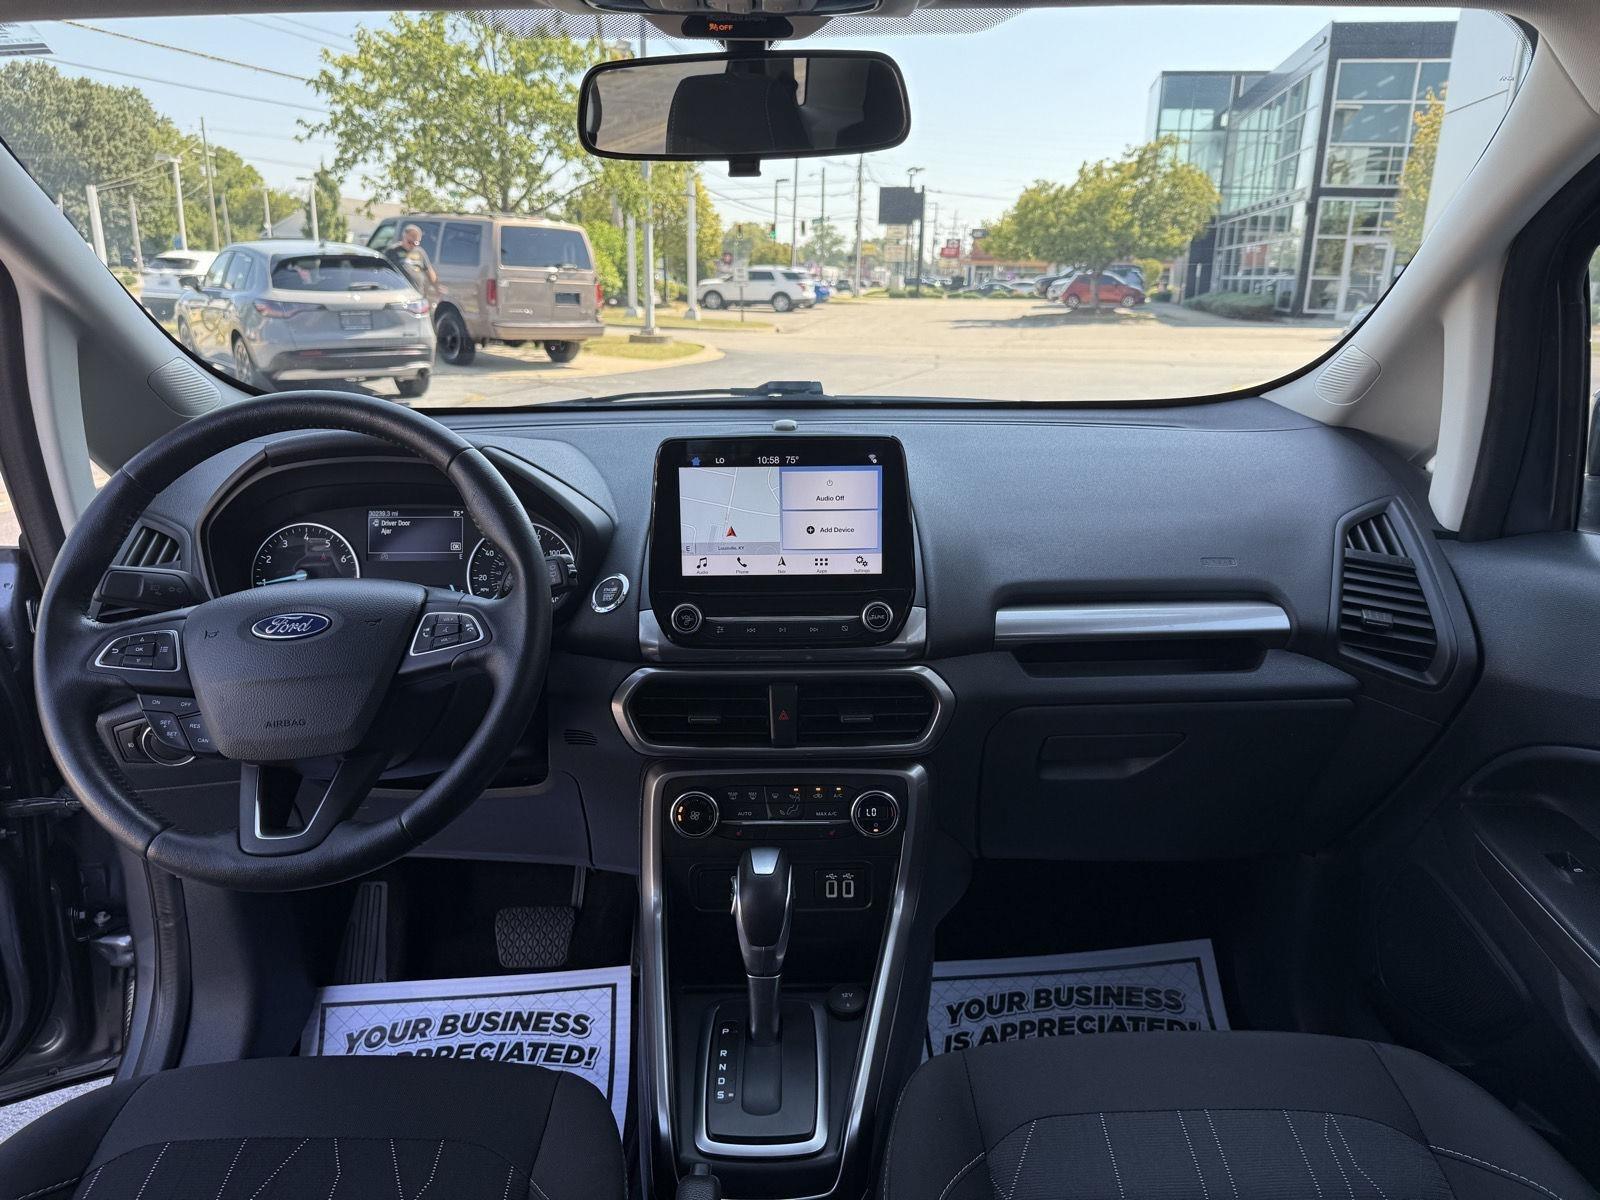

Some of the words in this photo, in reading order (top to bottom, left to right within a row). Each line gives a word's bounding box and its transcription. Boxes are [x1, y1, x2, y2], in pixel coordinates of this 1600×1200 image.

[757, 456, 780, 464] 10:58
[785, 456, 800, 464] 75°
[381, 519, 398, 527] Driver
[397, 519, 411, 527] Door
[819, 526, 833, 534] Add
[833, 526, 855, 534] Device
[303, 532, 309, 541] 4
[282, 540, 288, 548] 3
[325, 540, 331, 548] 5
[266, 555, 272, 564] 2
[340, 554, 347, 563] 6
[265, 615, 314, 634] Ford
[265, 718, 306, 729] AIRBAG
[865, 807, 877, 817] LO
[945, 991, 1027, 1026] YOUR
[1034, 985, 1185, 1012] BUSINESS
[346, 1017, 434, 1055] YOUR
[437, 1010, 595, 1037] BUSINESS
[944, 1029, 973, 1053] IS
[718, 1063, 727, 1071] N
[717, 1077, 726, 1085] D
[717, 1091, 725, 1099] S
